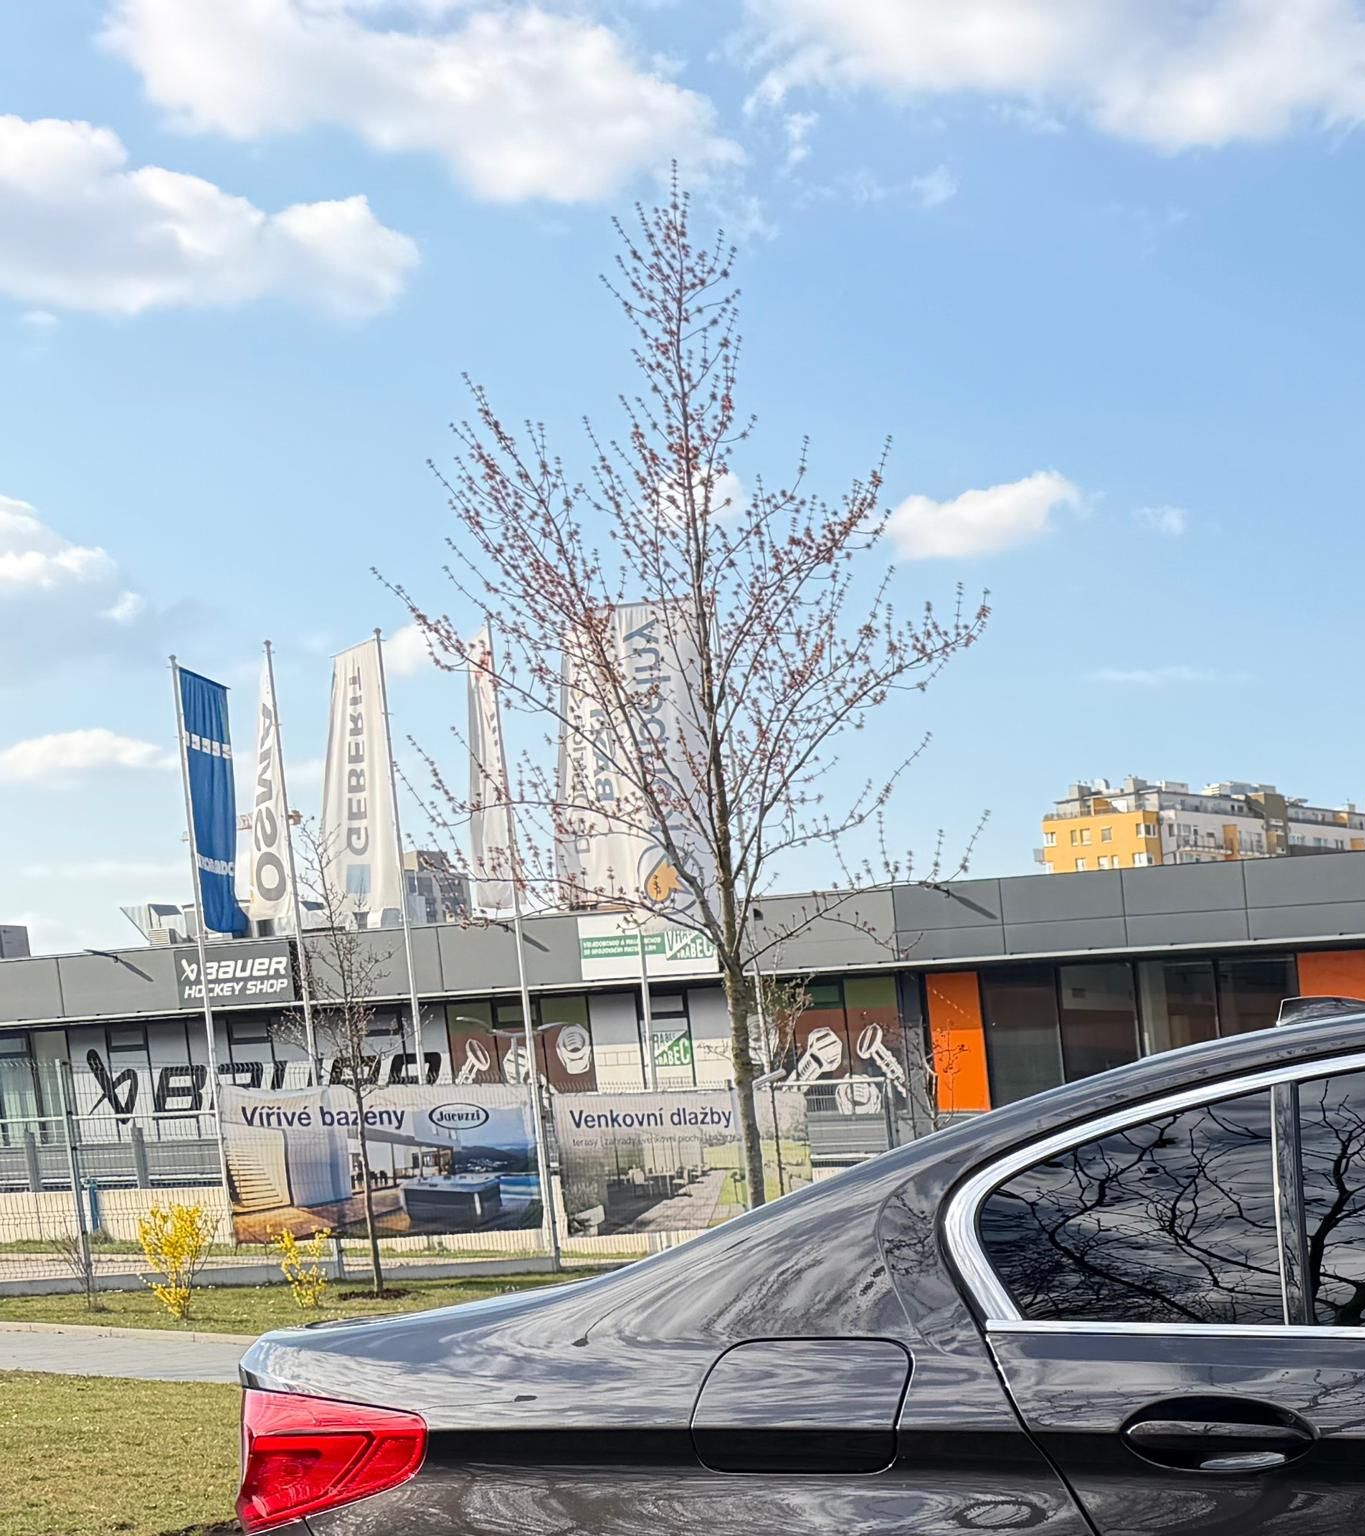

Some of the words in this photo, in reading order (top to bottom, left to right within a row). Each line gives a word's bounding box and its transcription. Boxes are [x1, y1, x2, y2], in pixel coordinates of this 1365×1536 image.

[200, 957, 288, 980] BAUER
[184, 982, 244, 999] HOCKEY
[246, 979, 288, 995] SHOP
[241, 1105, 311, 1127] Vířivé
[320, 1105, 405, 1129] bazény
[436, 1109, 481, 1123] Jacuzzi
[569, 1107, 664, 1129] Venkovní
[670, 1106, 732, 1129] dlažby
